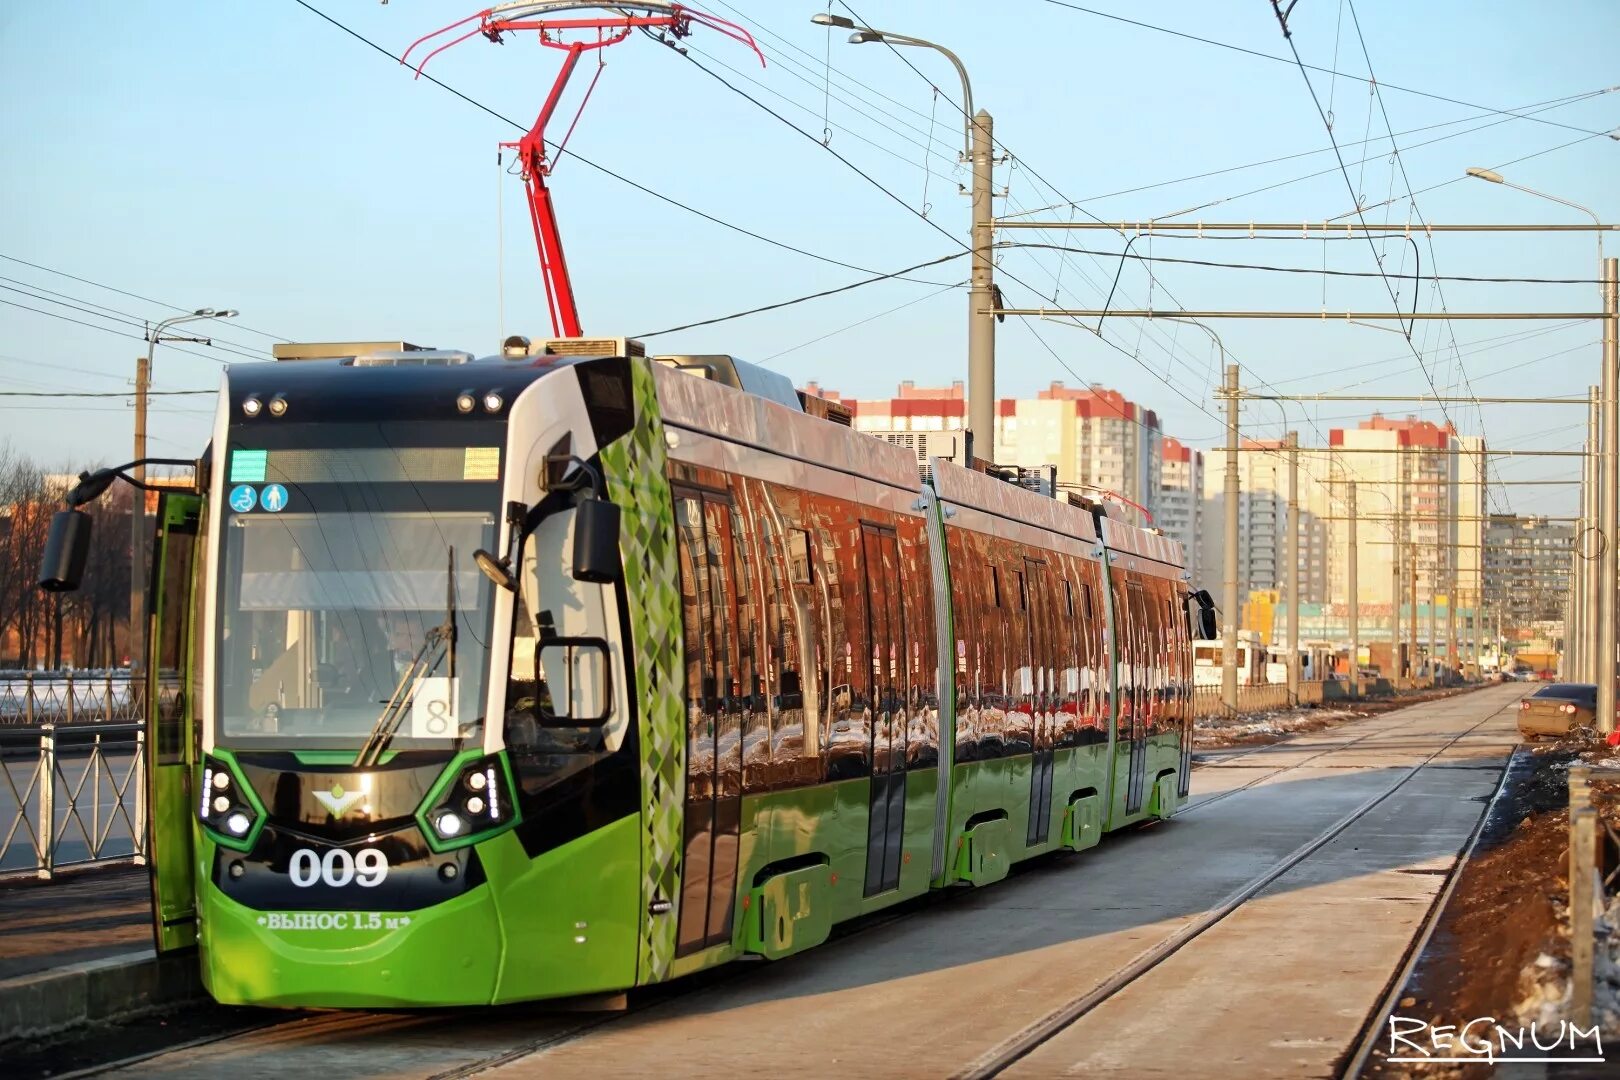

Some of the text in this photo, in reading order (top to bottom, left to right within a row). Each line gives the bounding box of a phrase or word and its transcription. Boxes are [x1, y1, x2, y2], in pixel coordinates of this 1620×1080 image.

[426, 700, 448, 735] 8
[289, 848, 389, 887] 009
[267, 913, 348, 929] ВЫНОС
[353, 912, 382, 929] 1.5
